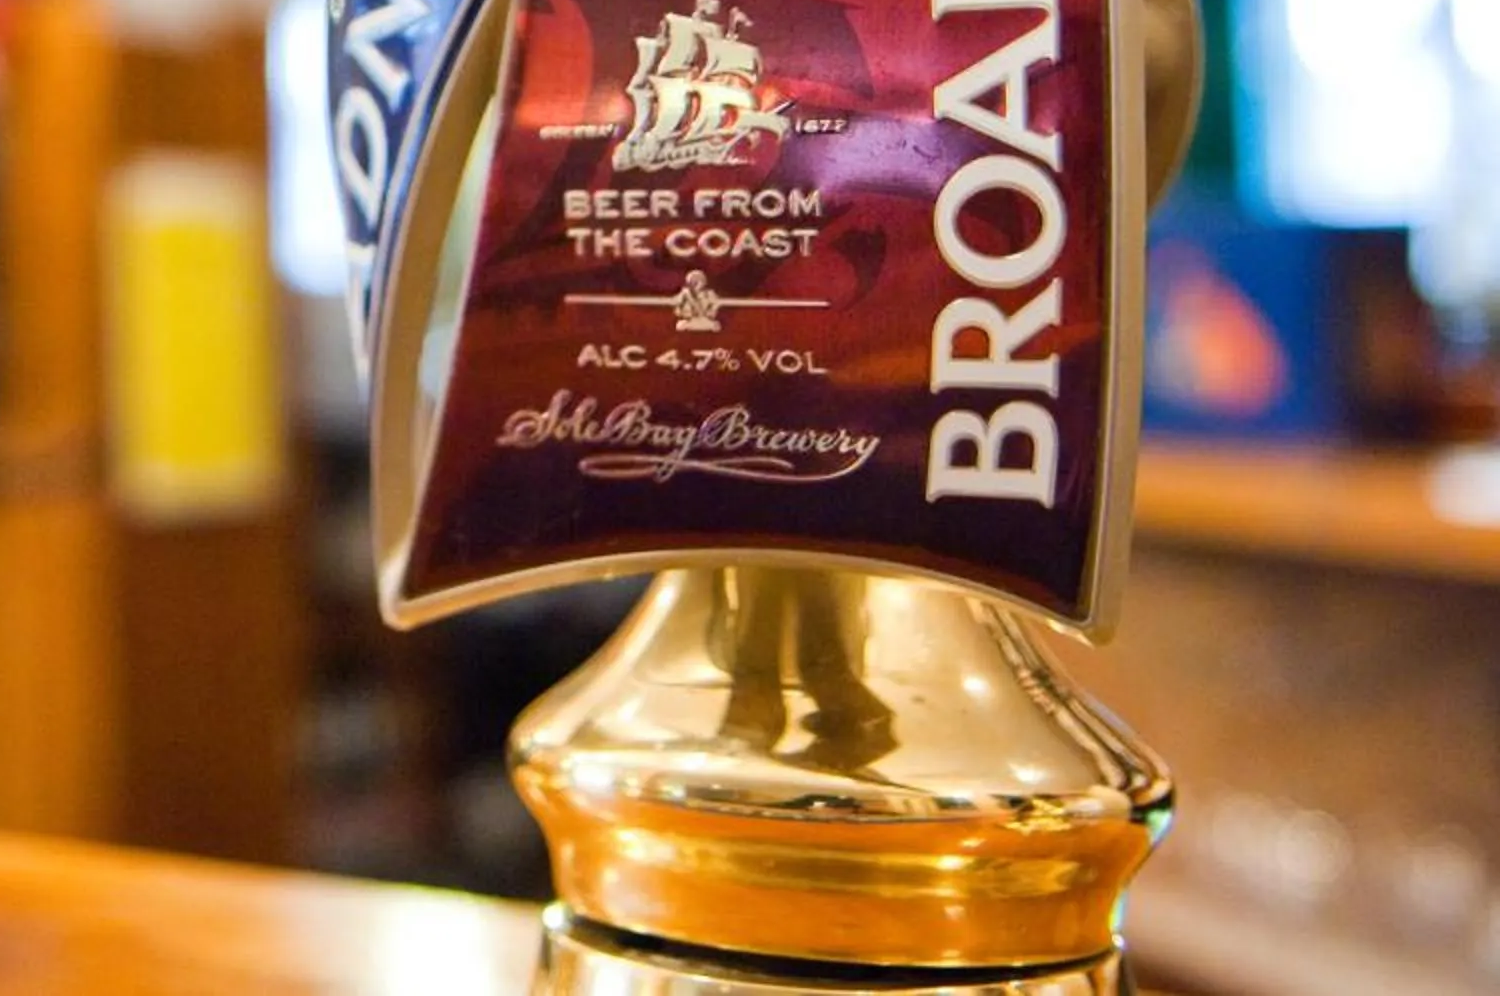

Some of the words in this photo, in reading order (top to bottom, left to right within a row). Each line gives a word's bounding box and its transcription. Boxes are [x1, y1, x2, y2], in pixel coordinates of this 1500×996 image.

[563, 188, 680, 220] BEER
[693, 188, 822, 218] FROM
[565, 227, 654, 257] THE
[665, 227, 820, 258] COAST
[576, 343, 647, 369] ALC
[654, 347, 741, 372] 4.7%
[746, 349, 829, 375] VOL
[495, 388, 601, 450] Sole
[600, 400, 701, 470] Bay
[699, 402, 881, 466] Brewery
